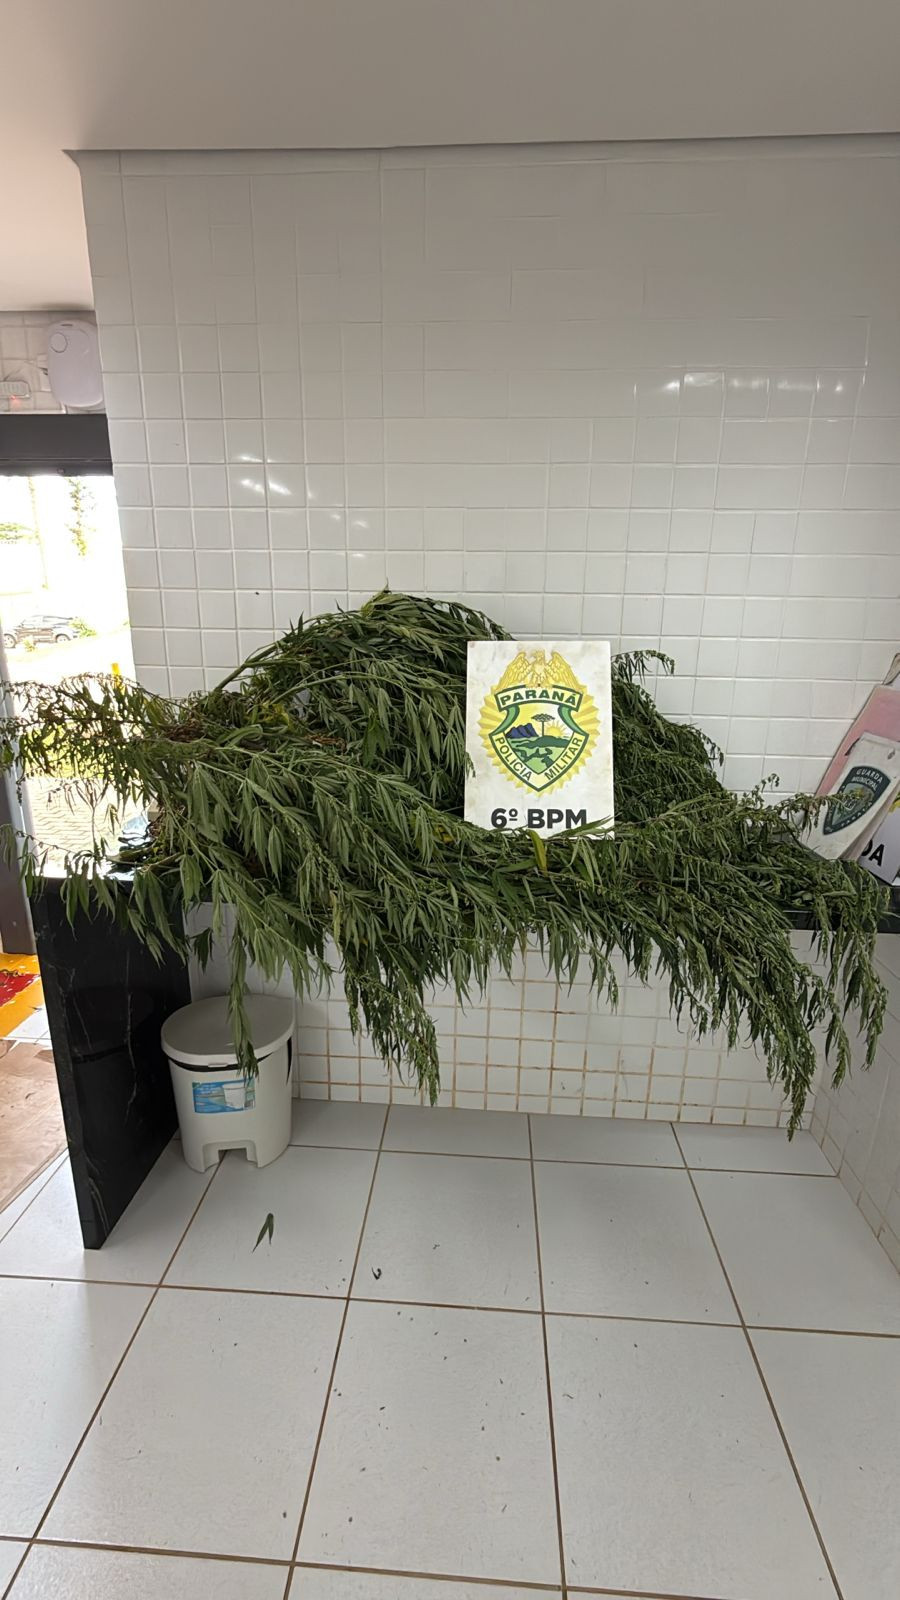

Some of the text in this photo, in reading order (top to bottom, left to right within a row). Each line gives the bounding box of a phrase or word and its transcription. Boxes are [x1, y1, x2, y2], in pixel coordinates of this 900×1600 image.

[500, 690, 577, 705] PARANÁ
[544, 737, 583, 780] MILITAR
[856, 769, 883, 783] GUARDA
[491, 808, 587, 828] 6º BPM
